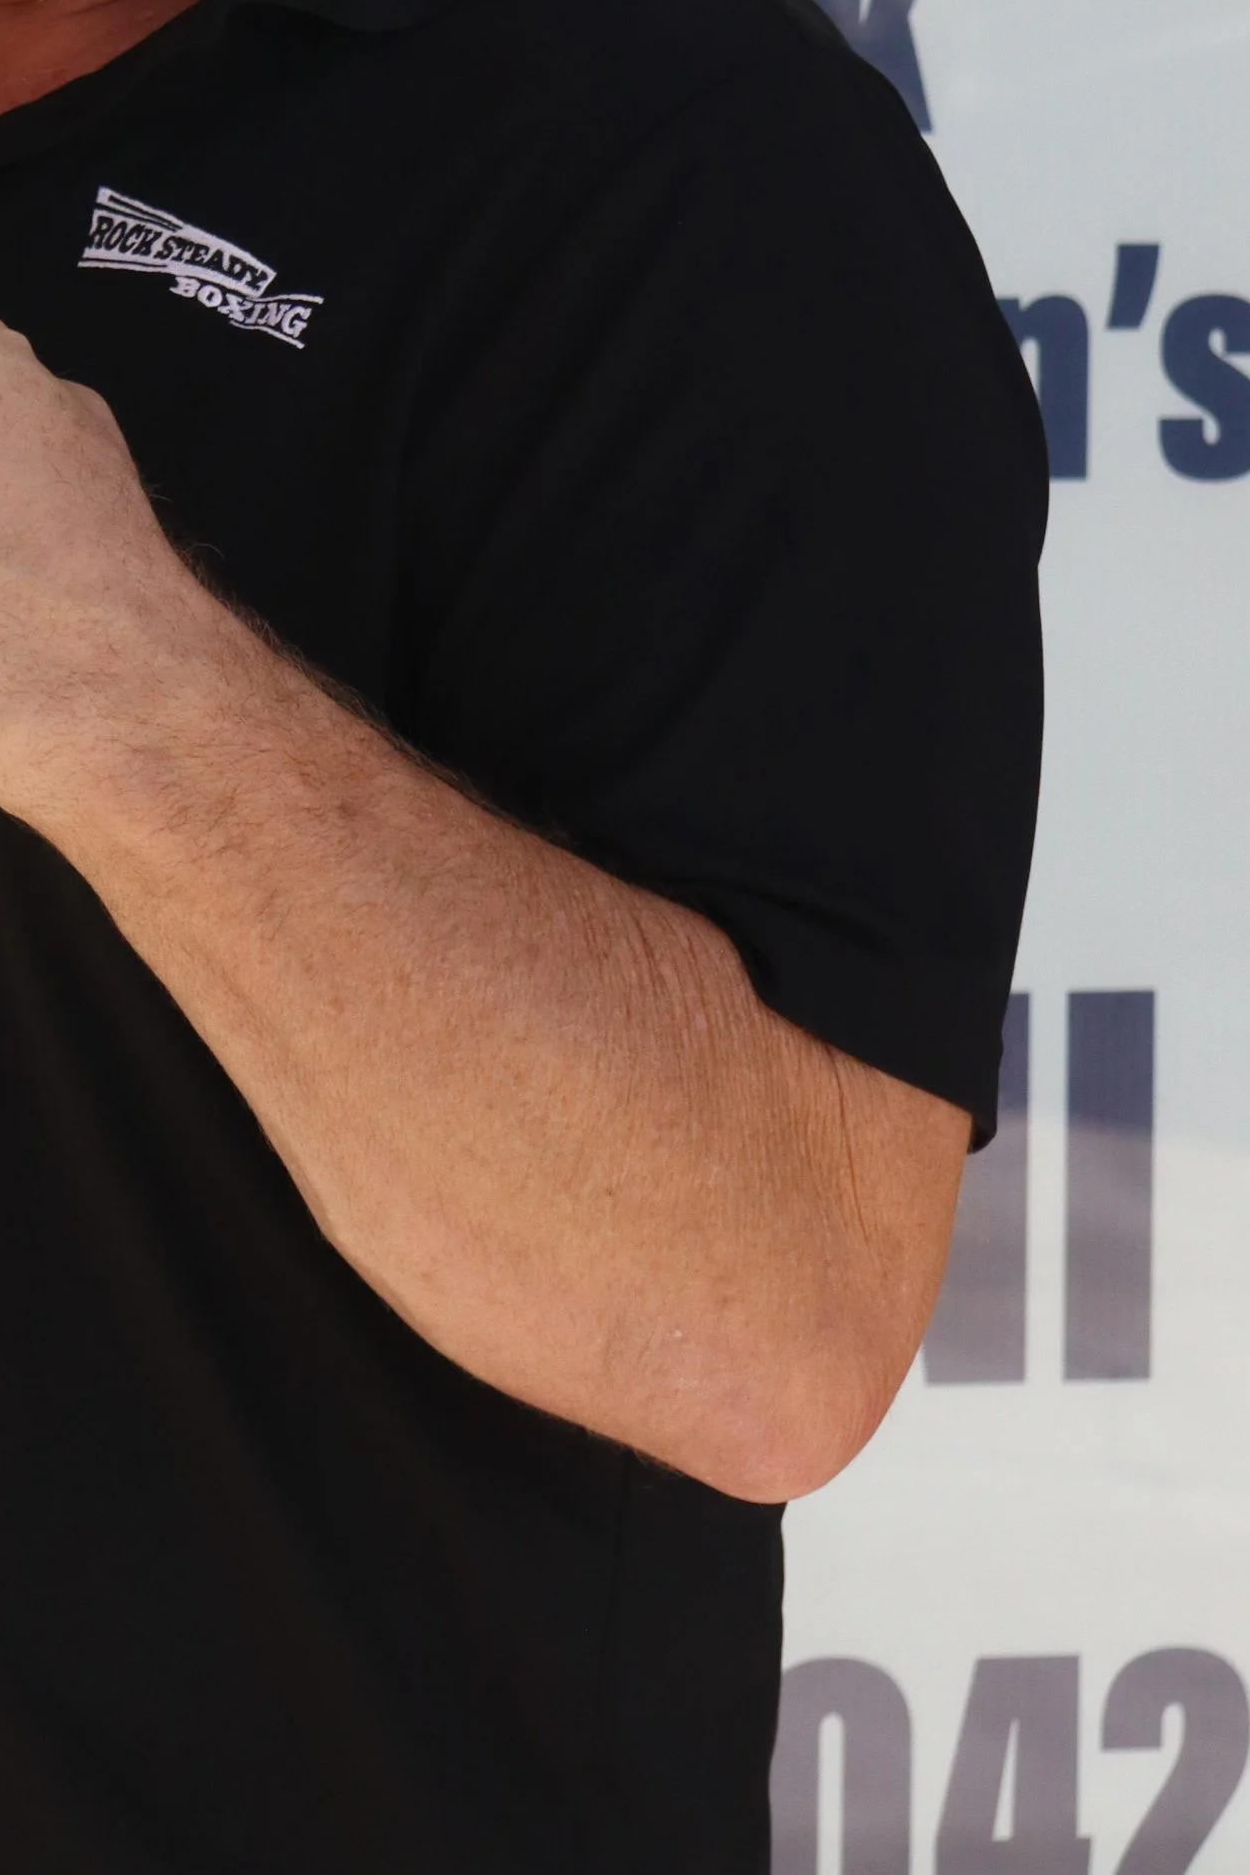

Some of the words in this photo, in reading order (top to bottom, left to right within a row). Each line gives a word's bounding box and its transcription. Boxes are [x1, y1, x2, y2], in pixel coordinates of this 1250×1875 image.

[87, 214, 163, 259] ROCK
[152, 235, 271, 292] STEADY
[169, 276, 312, 338] BOXING
